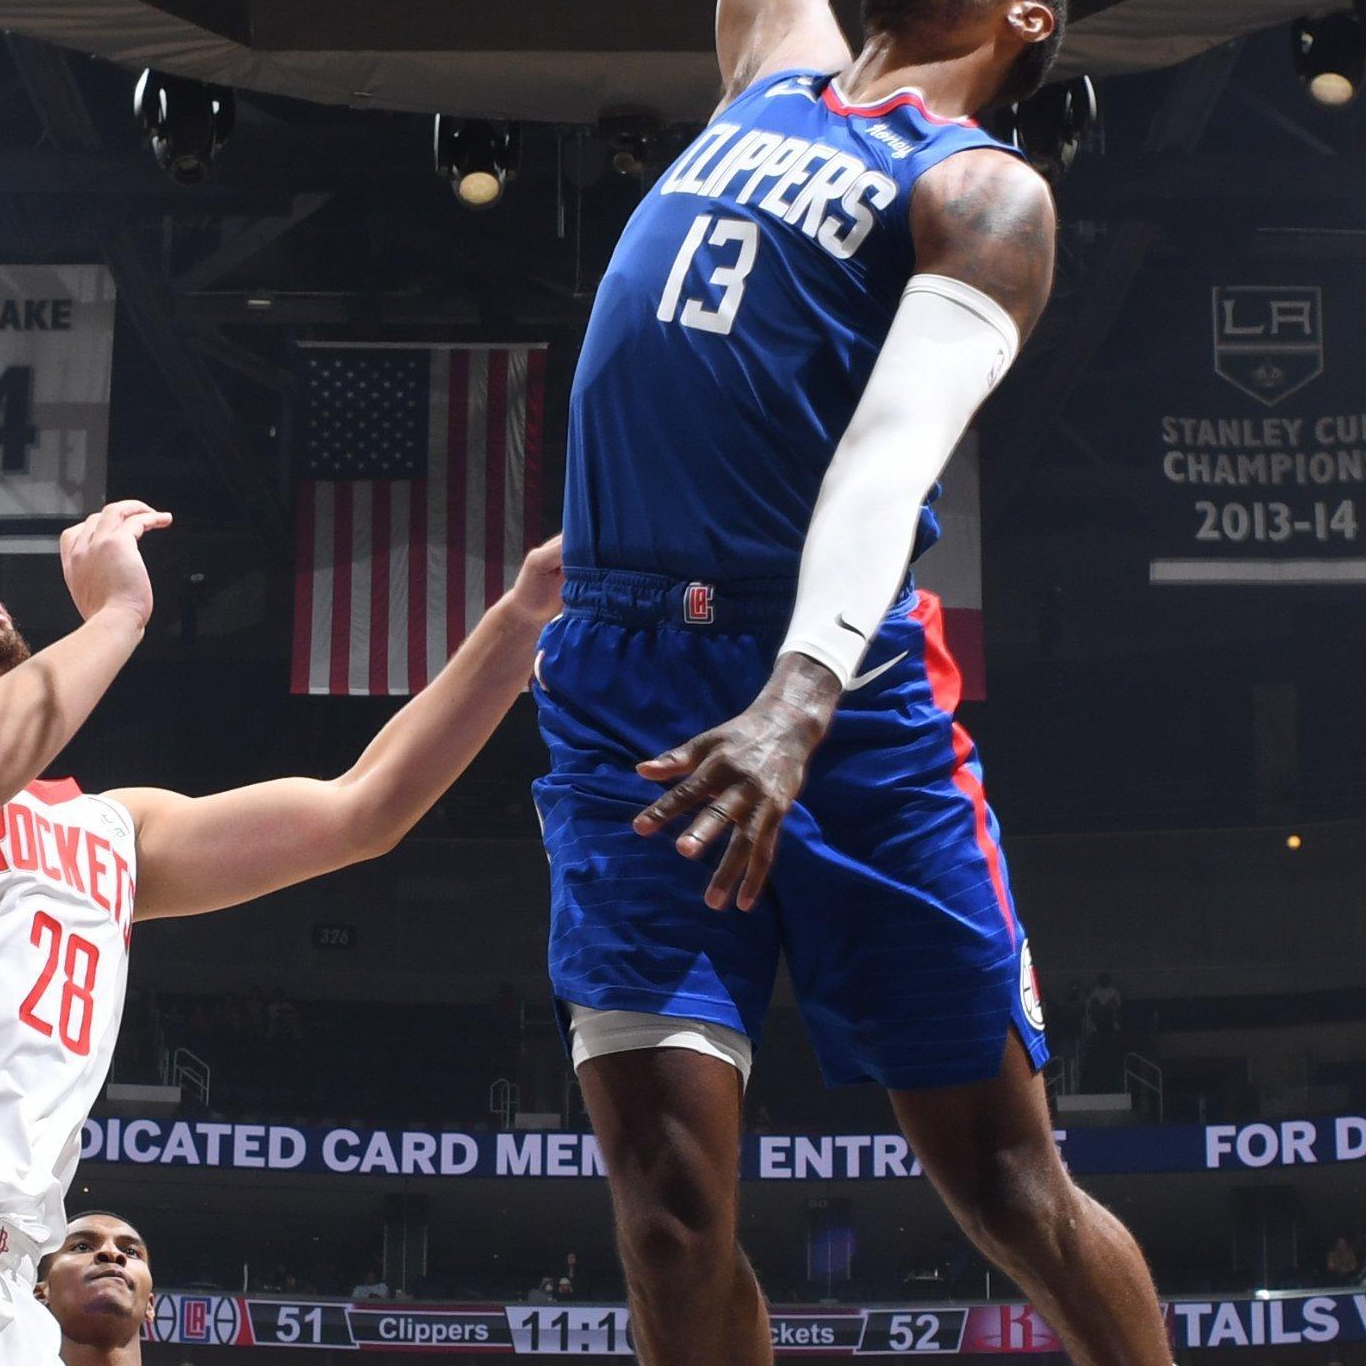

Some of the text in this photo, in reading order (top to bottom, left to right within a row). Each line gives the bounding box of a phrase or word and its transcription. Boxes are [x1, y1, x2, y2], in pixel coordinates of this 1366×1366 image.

[660, 123, 897, 260] CLIPPERS
[656, 215, 759, 335] 13
[1223, 300, 1311, 334] LA
[1162, 416, 1302, 447] STANLEY
[1194, 499, 1358, 542] 2013-14
[18, 910, 100, 1056] 28
[322, 1129, 479, 1176] CARD
[1206, 1120, 1317, 1168] FOR
[275, 1305, 322, 1344] 51
[378, 1317, 489, 1343] Clippers
[888, 1314, 941, 1352] 52
[1175, 1297, 1340, 1348] TAILS
